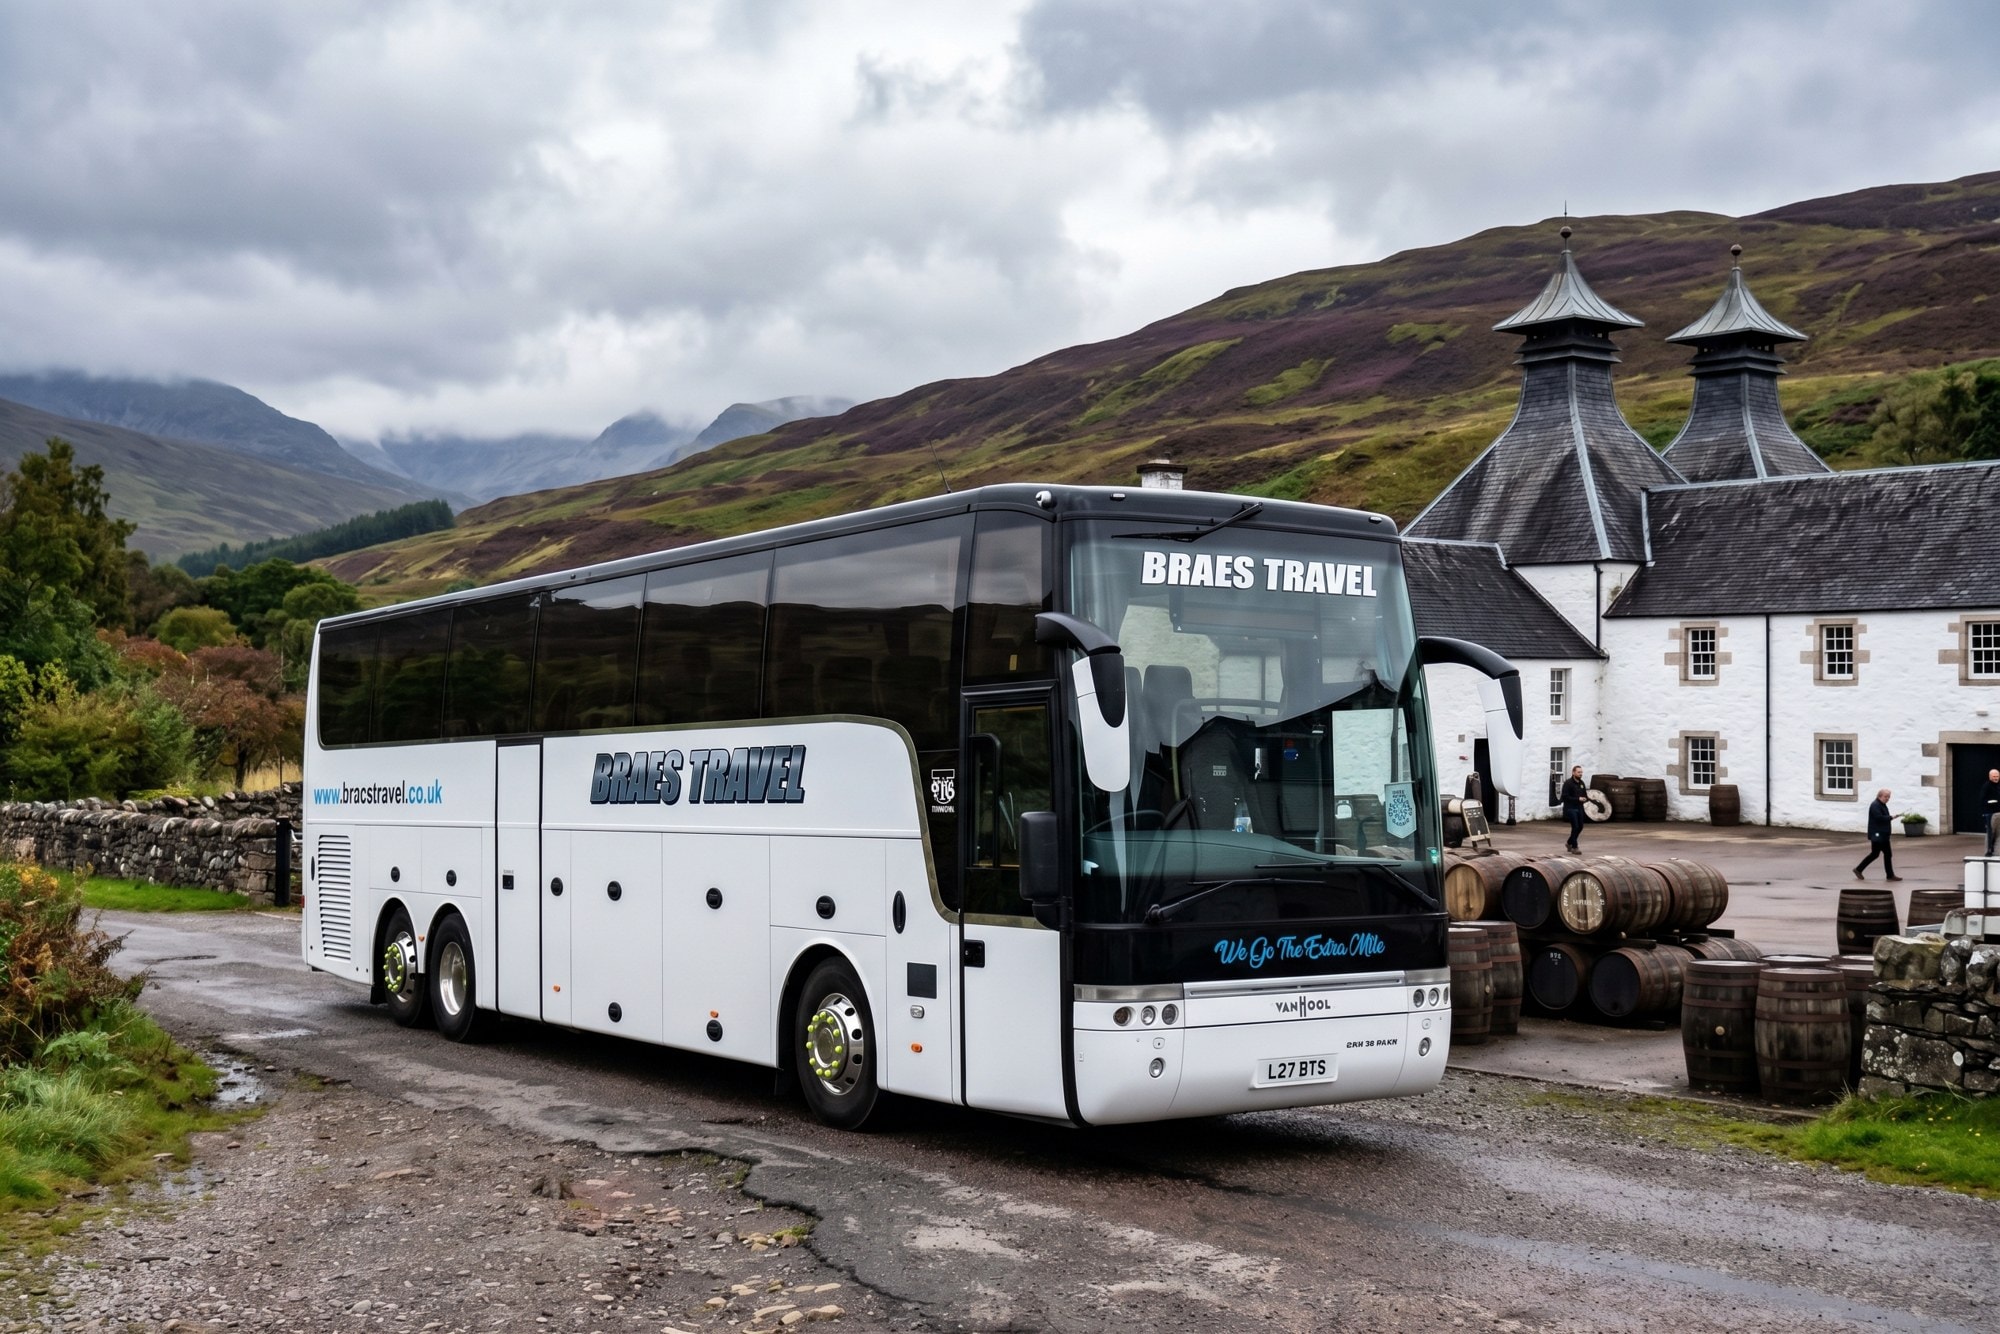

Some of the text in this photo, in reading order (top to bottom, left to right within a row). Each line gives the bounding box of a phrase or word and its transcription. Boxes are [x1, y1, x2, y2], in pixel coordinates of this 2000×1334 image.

[1141, 551, 1377, 598] BRAES TRAVEL
[590, 744, 806, 806] BRAES TRAVEL
[1214, 932, 1386, 969] We Go The Extra Mile
[1268, 1059, 1327, 1080] L27 BTS
